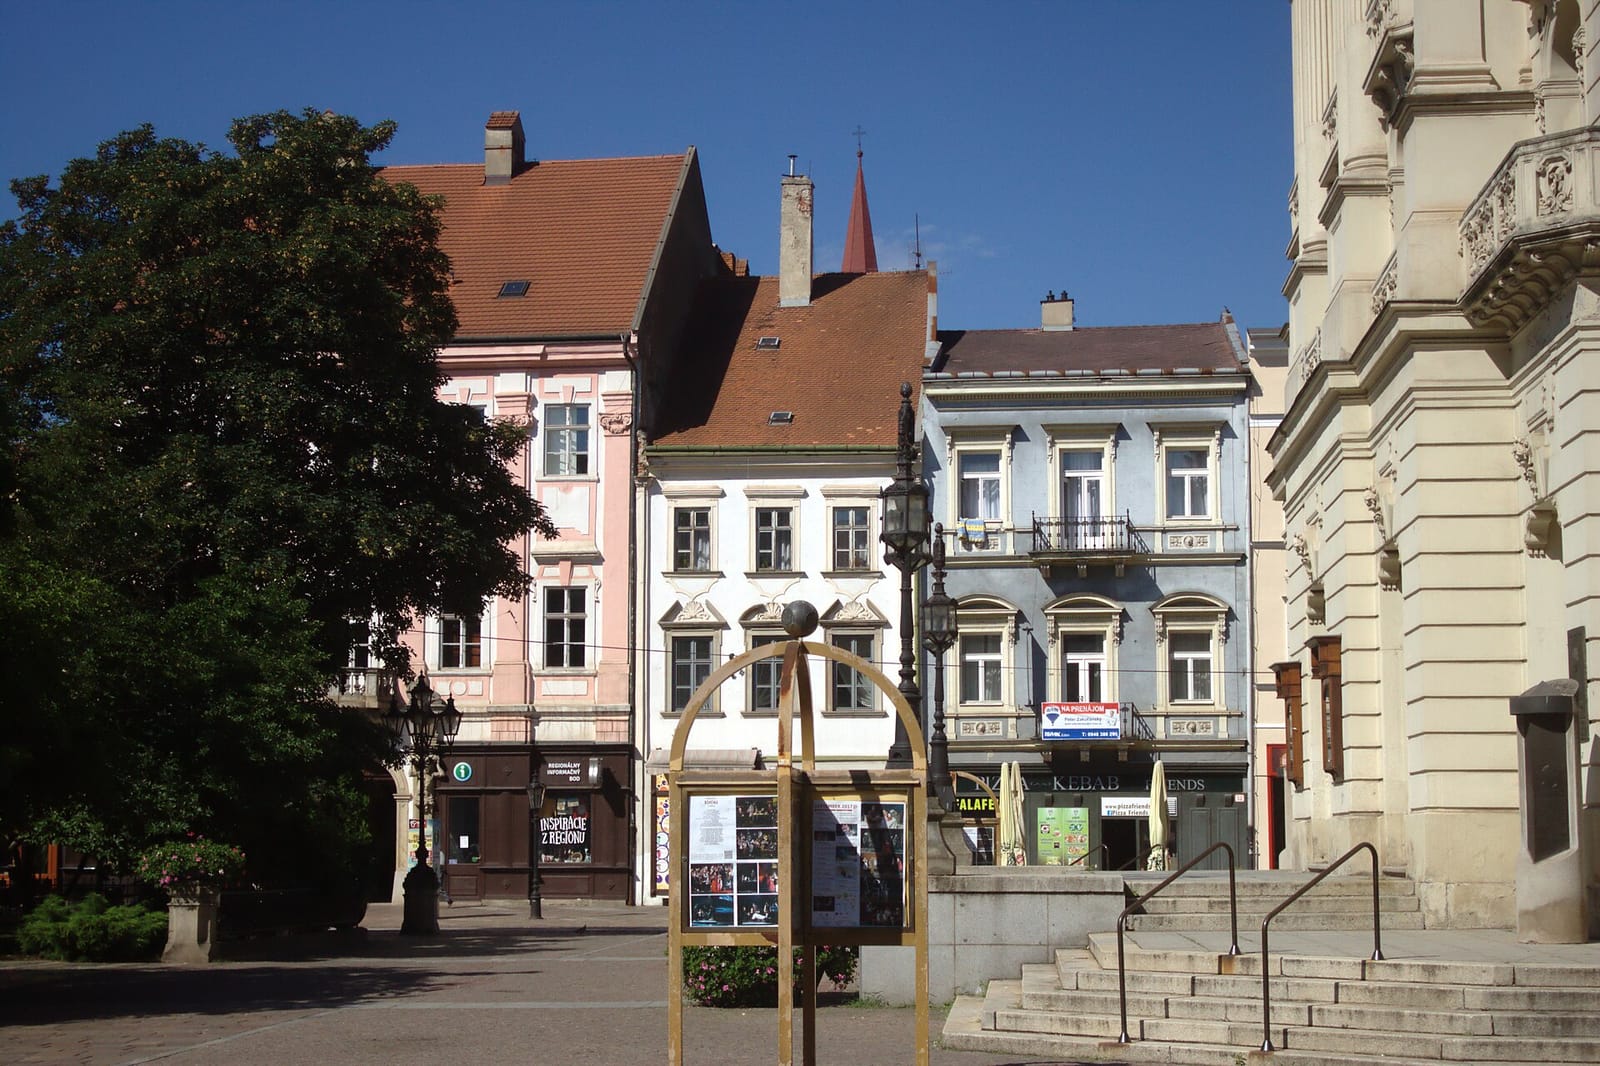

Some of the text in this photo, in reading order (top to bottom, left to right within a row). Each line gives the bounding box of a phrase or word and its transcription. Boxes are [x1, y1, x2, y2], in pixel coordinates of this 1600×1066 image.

[1071, 704, 1105, 713] PRENÁJOM
[975, 776, 1030, 791] PIZA
[1053, 776, 1120, 791] KEBAB
[956, 798, 996, 811] ALAFE
[541, 832, 548, 845] Z
